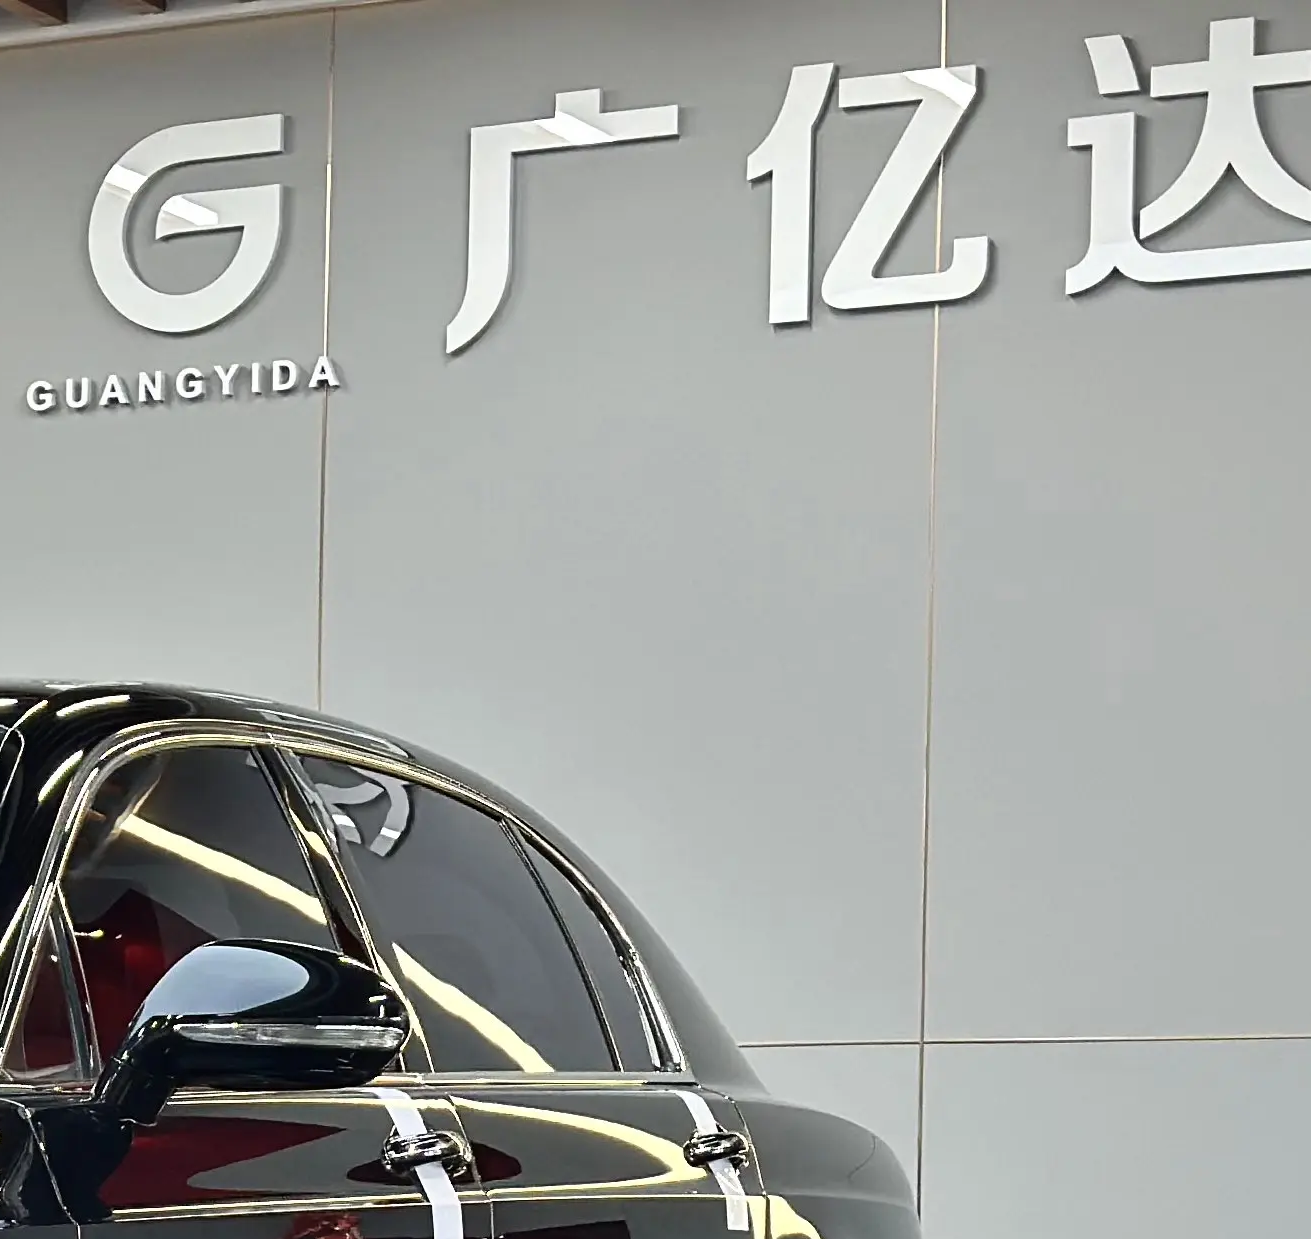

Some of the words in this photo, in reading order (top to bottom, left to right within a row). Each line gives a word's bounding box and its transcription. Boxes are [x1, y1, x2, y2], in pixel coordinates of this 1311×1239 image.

[444, 16, 1311, 356] 广亿达
[26, 355, 341, 412] GUANGYIDA
